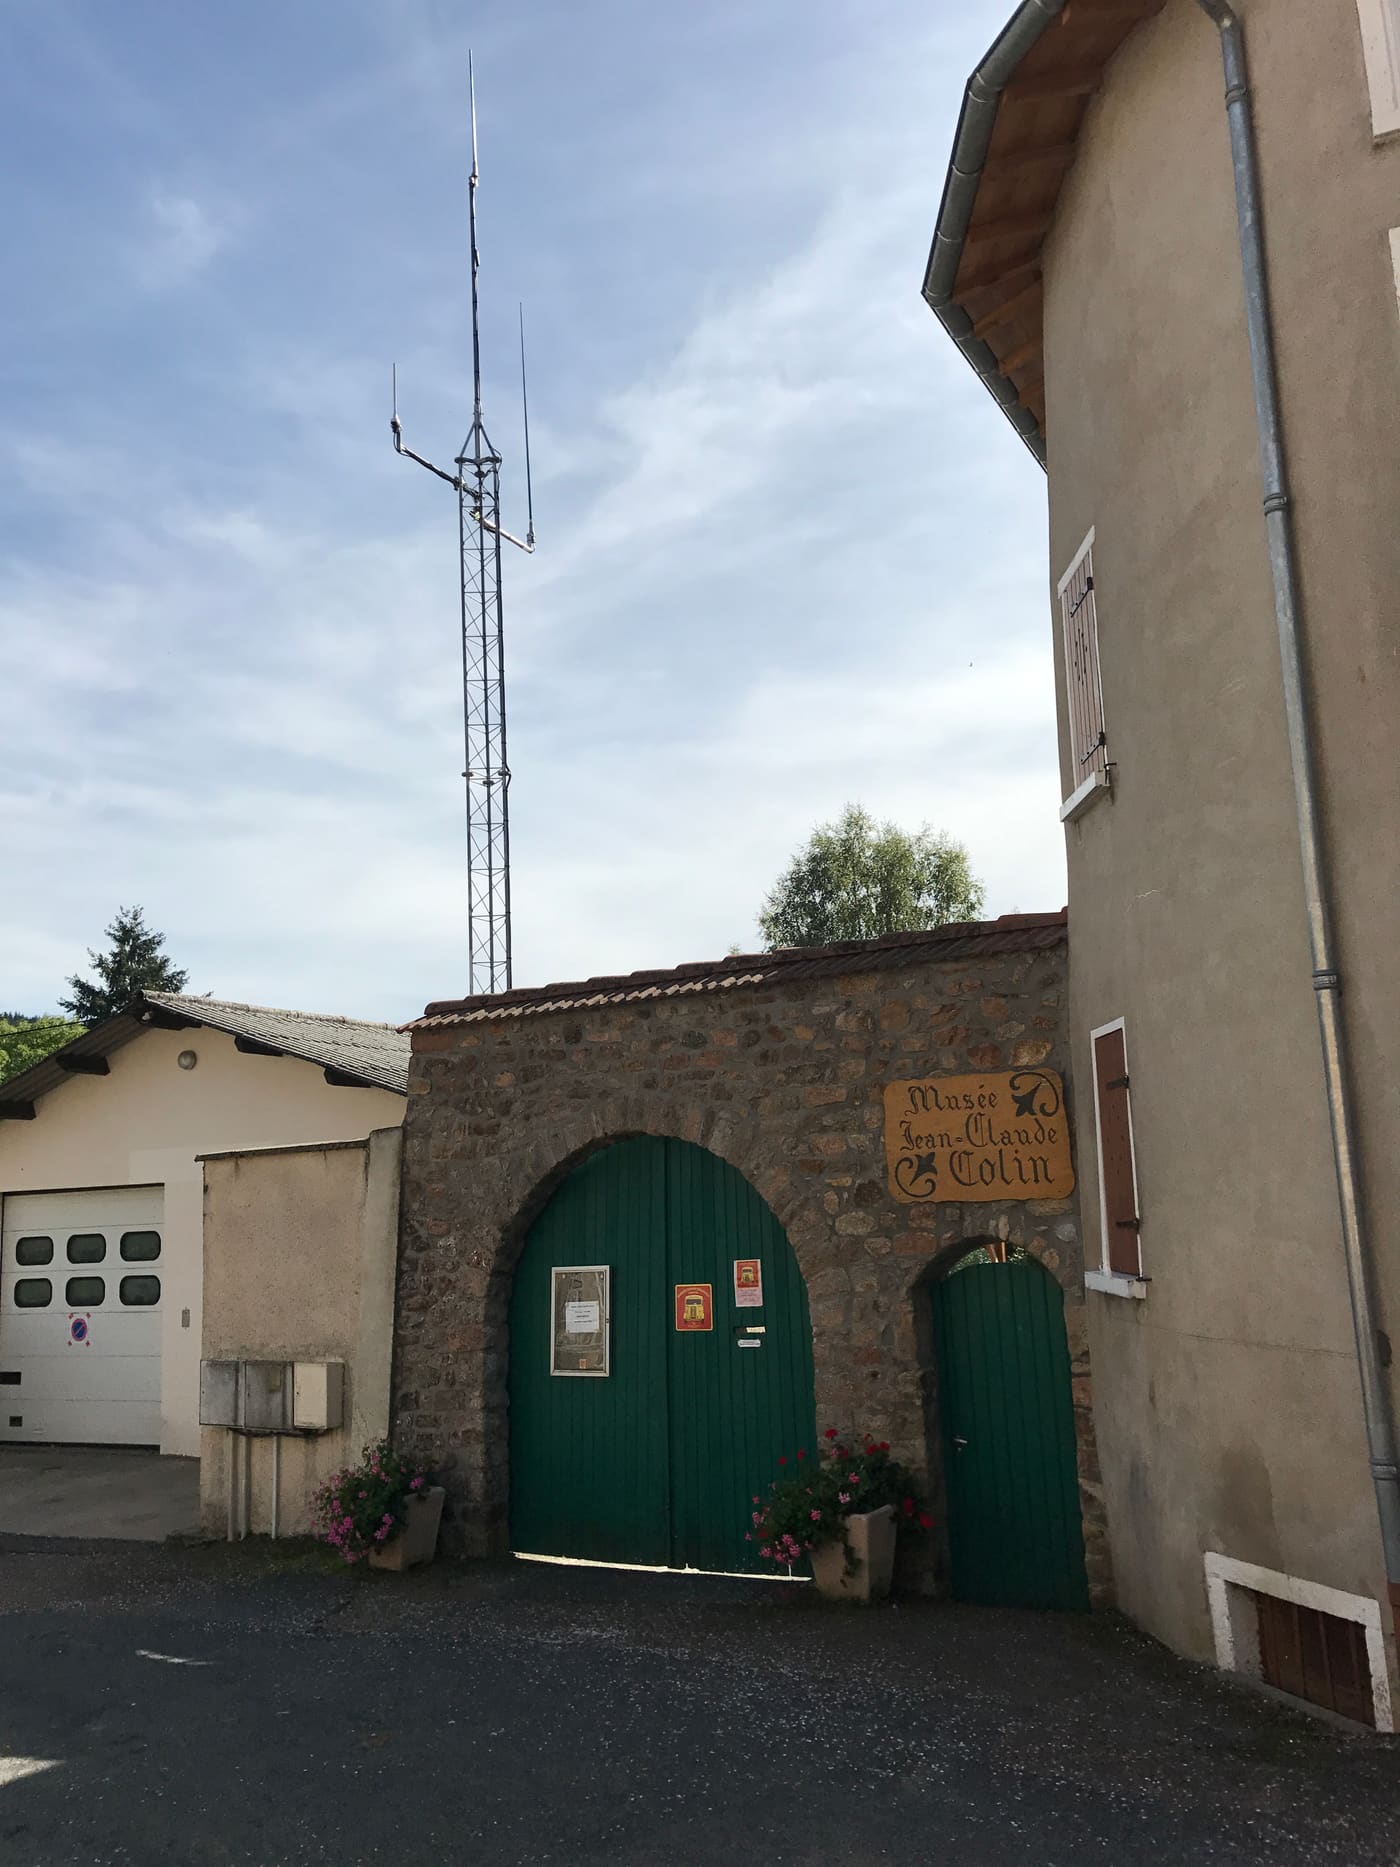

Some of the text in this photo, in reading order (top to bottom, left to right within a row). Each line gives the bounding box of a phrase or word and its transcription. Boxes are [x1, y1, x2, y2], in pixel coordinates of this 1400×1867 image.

[905, 1084, 998, 1116] Musée
[899, 1112, 1057, 1150] Jean-Claude
[950, 1149, 1055, 1186] Colin
